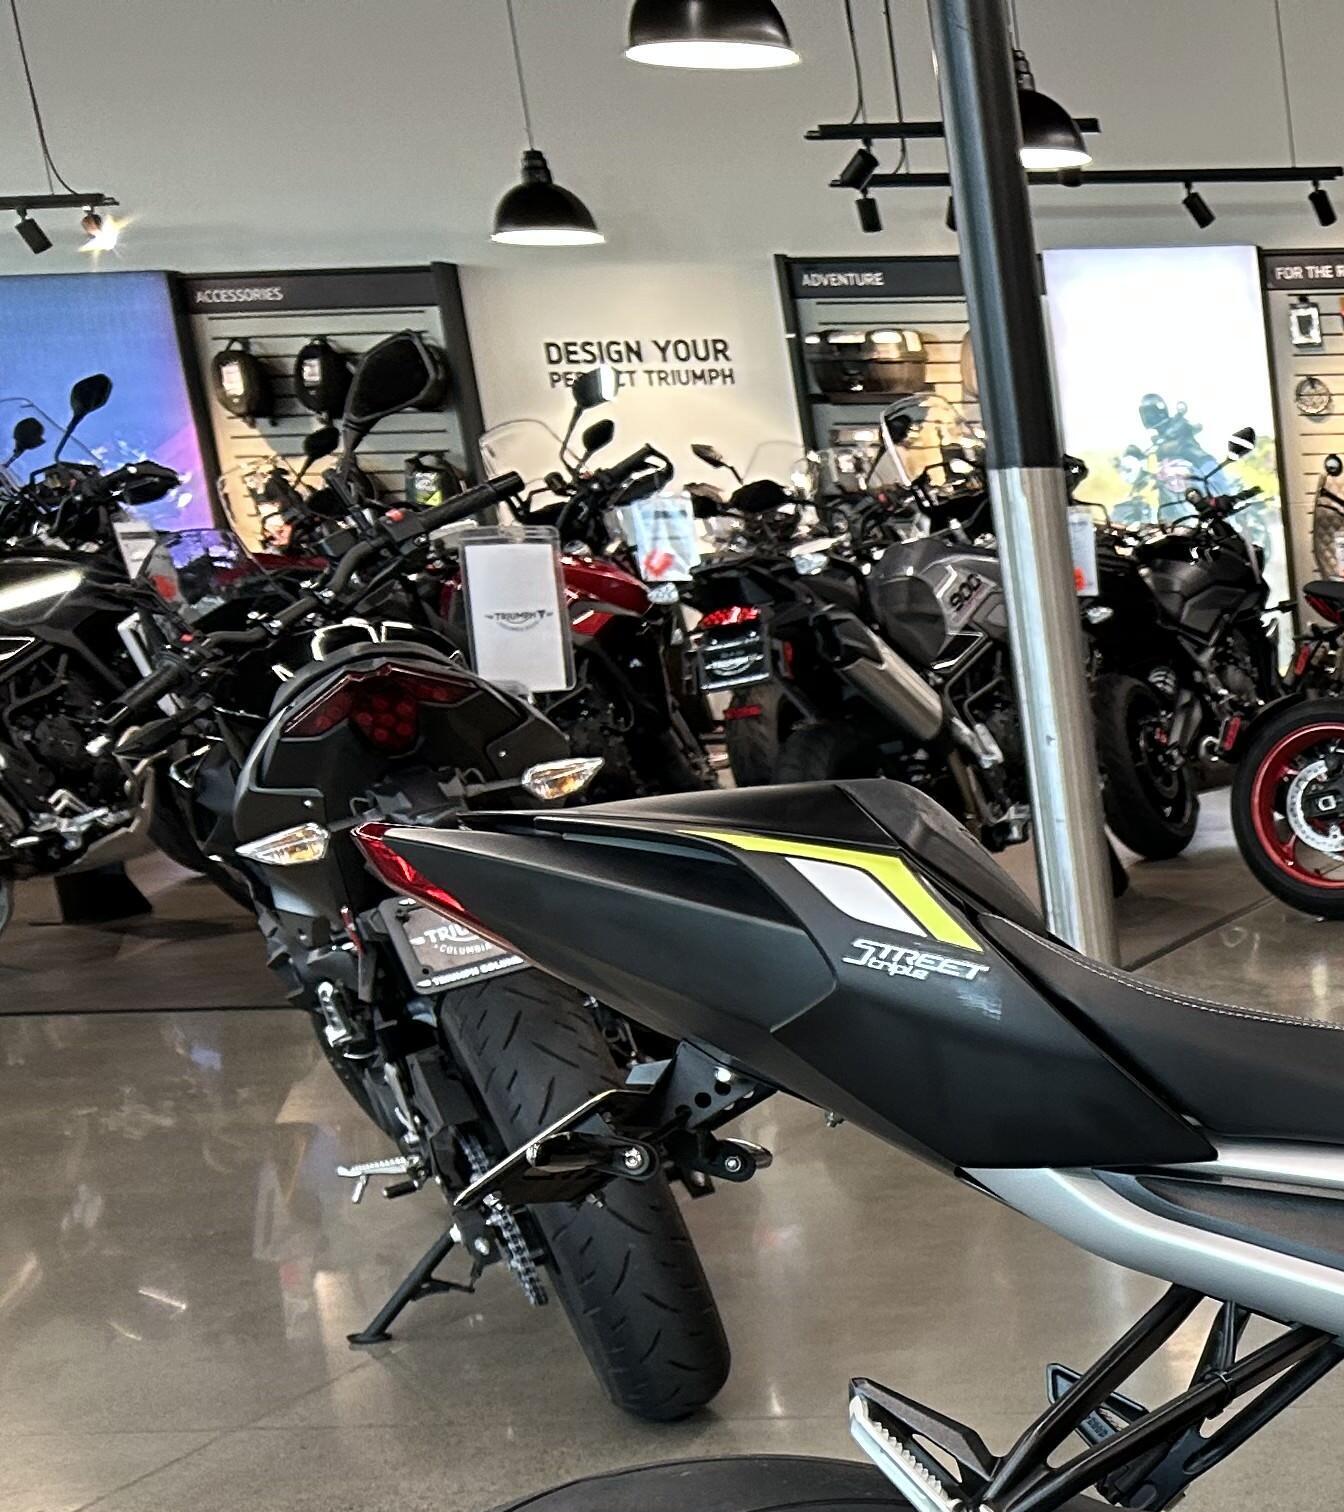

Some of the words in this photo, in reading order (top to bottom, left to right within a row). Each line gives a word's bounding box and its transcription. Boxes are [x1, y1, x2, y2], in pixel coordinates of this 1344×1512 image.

[802, 272, 885, 287] ADVENTURE
[1275, 266, 1304, 280] FOR
[1304, 265, 1334, 279] THE
[195, 286, 284, 303] ACCESSORIES
[543, 340, 644, 365] DESIGN
[651, 338, 732, 363] YOUR
[642, 367, 736, 388] TRIUMPH
[494, 611, 537, 621] TRIUMPH
[842, 938, 991, 981] STREET
